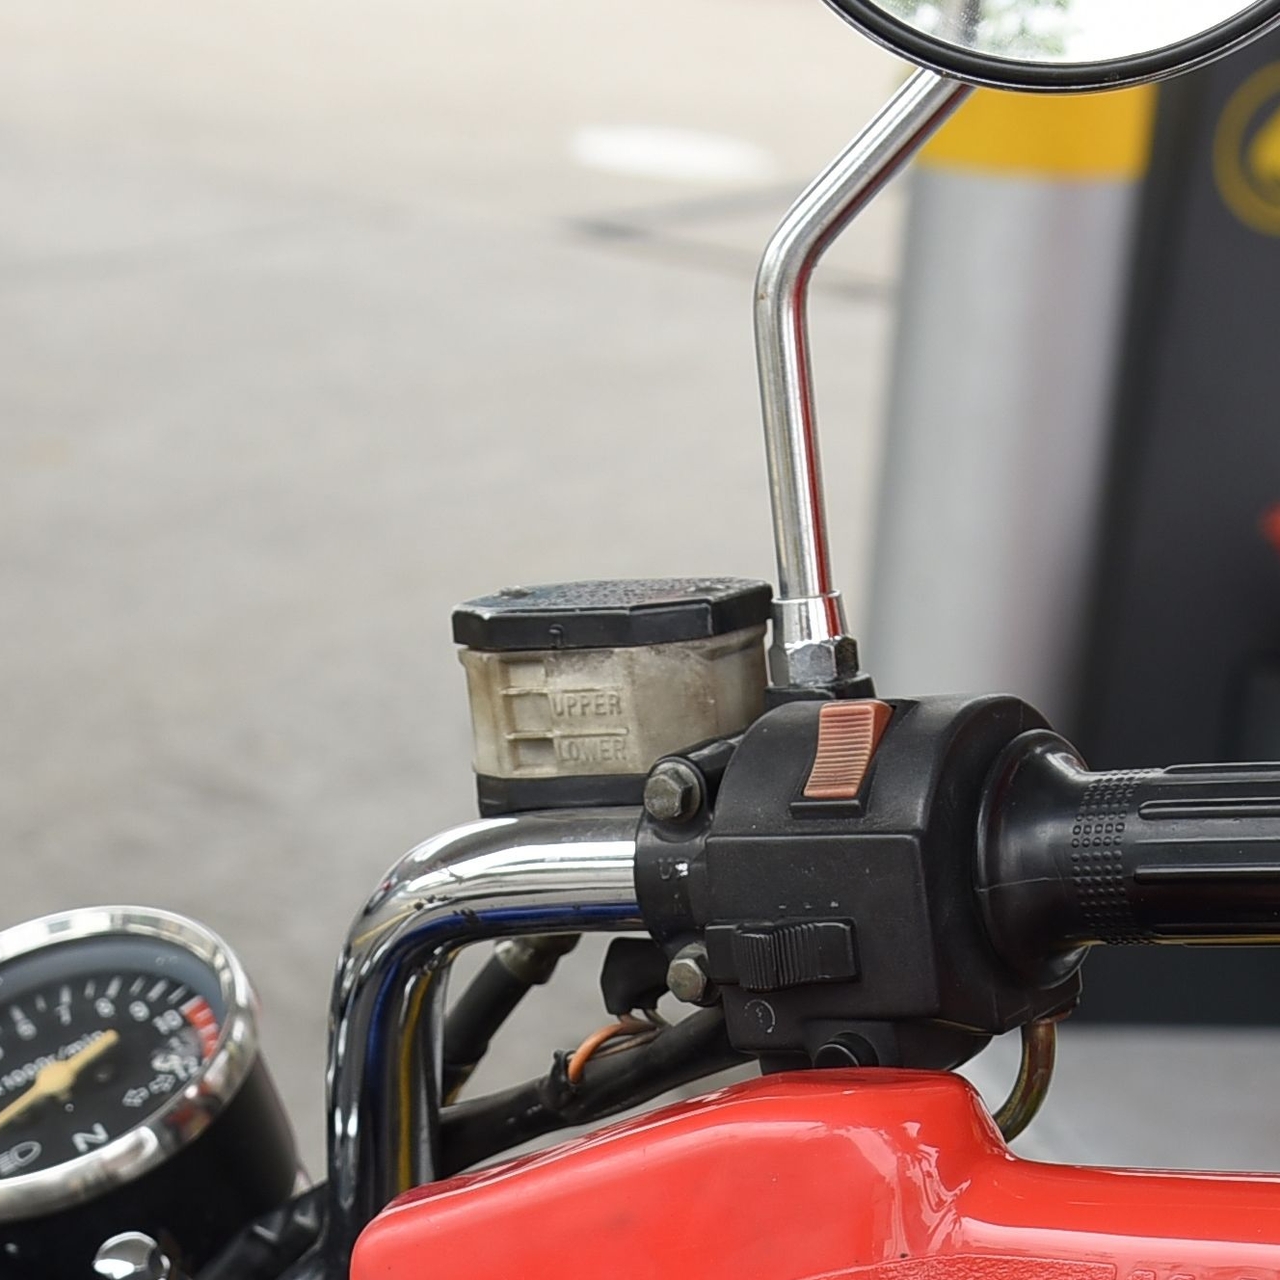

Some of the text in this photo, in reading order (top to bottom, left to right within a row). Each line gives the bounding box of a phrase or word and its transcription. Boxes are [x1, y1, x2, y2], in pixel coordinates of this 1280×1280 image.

[551, 692, 623, 717] UPPER
[557, 738, 628, 762] LOWER
[151, 1009, 183, 1035] 10
[73, 1122, 109, 1153] N
